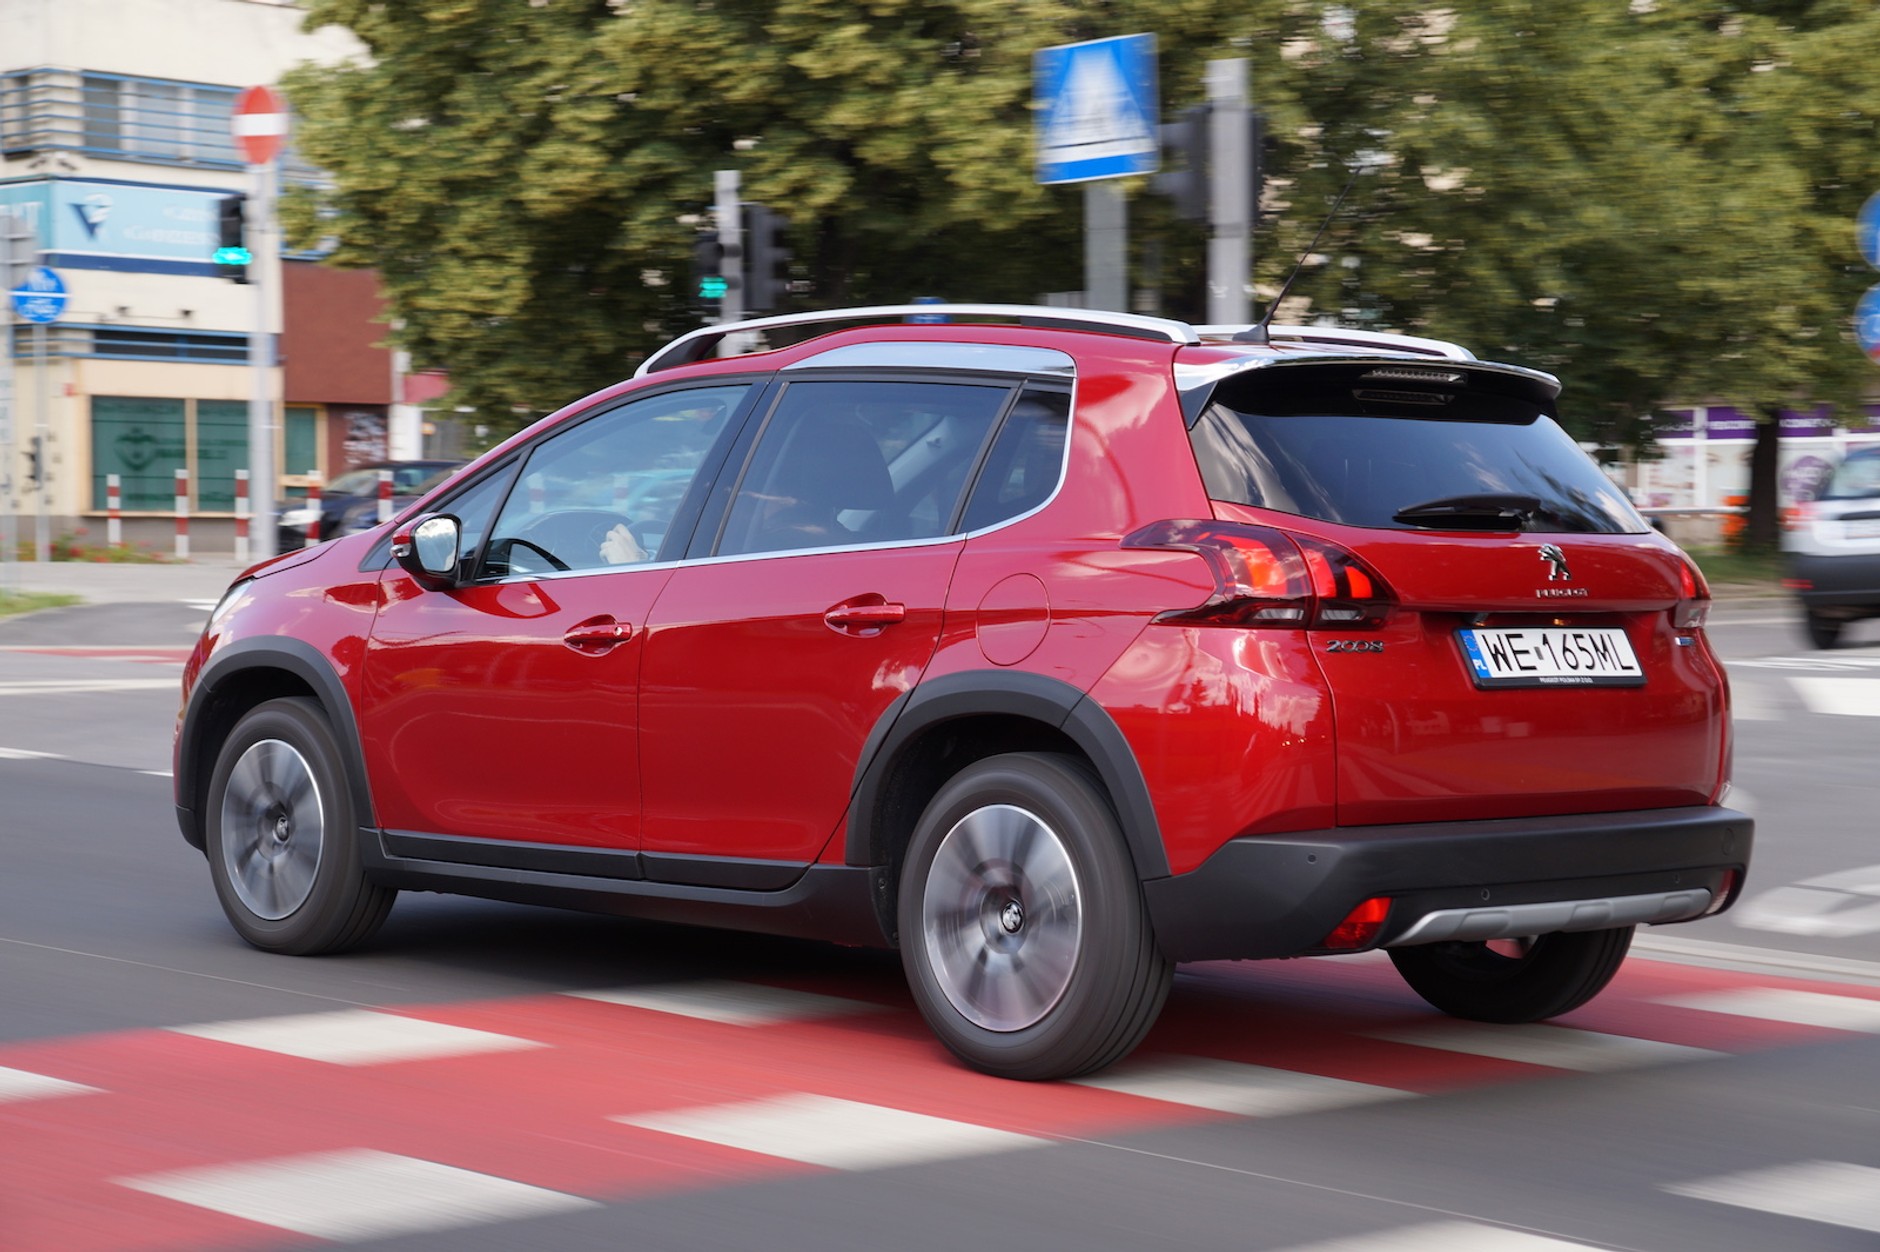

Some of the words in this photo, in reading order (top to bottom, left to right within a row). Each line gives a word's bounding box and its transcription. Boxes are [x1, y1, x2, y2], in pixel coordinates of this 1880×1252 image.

[1326, 639, 1384, 653] 2008
[1482, 633, 1538, 671] WE
[1542, 633, 1634, 671] 165ML
[1473, 659, 1487, 671] PL
